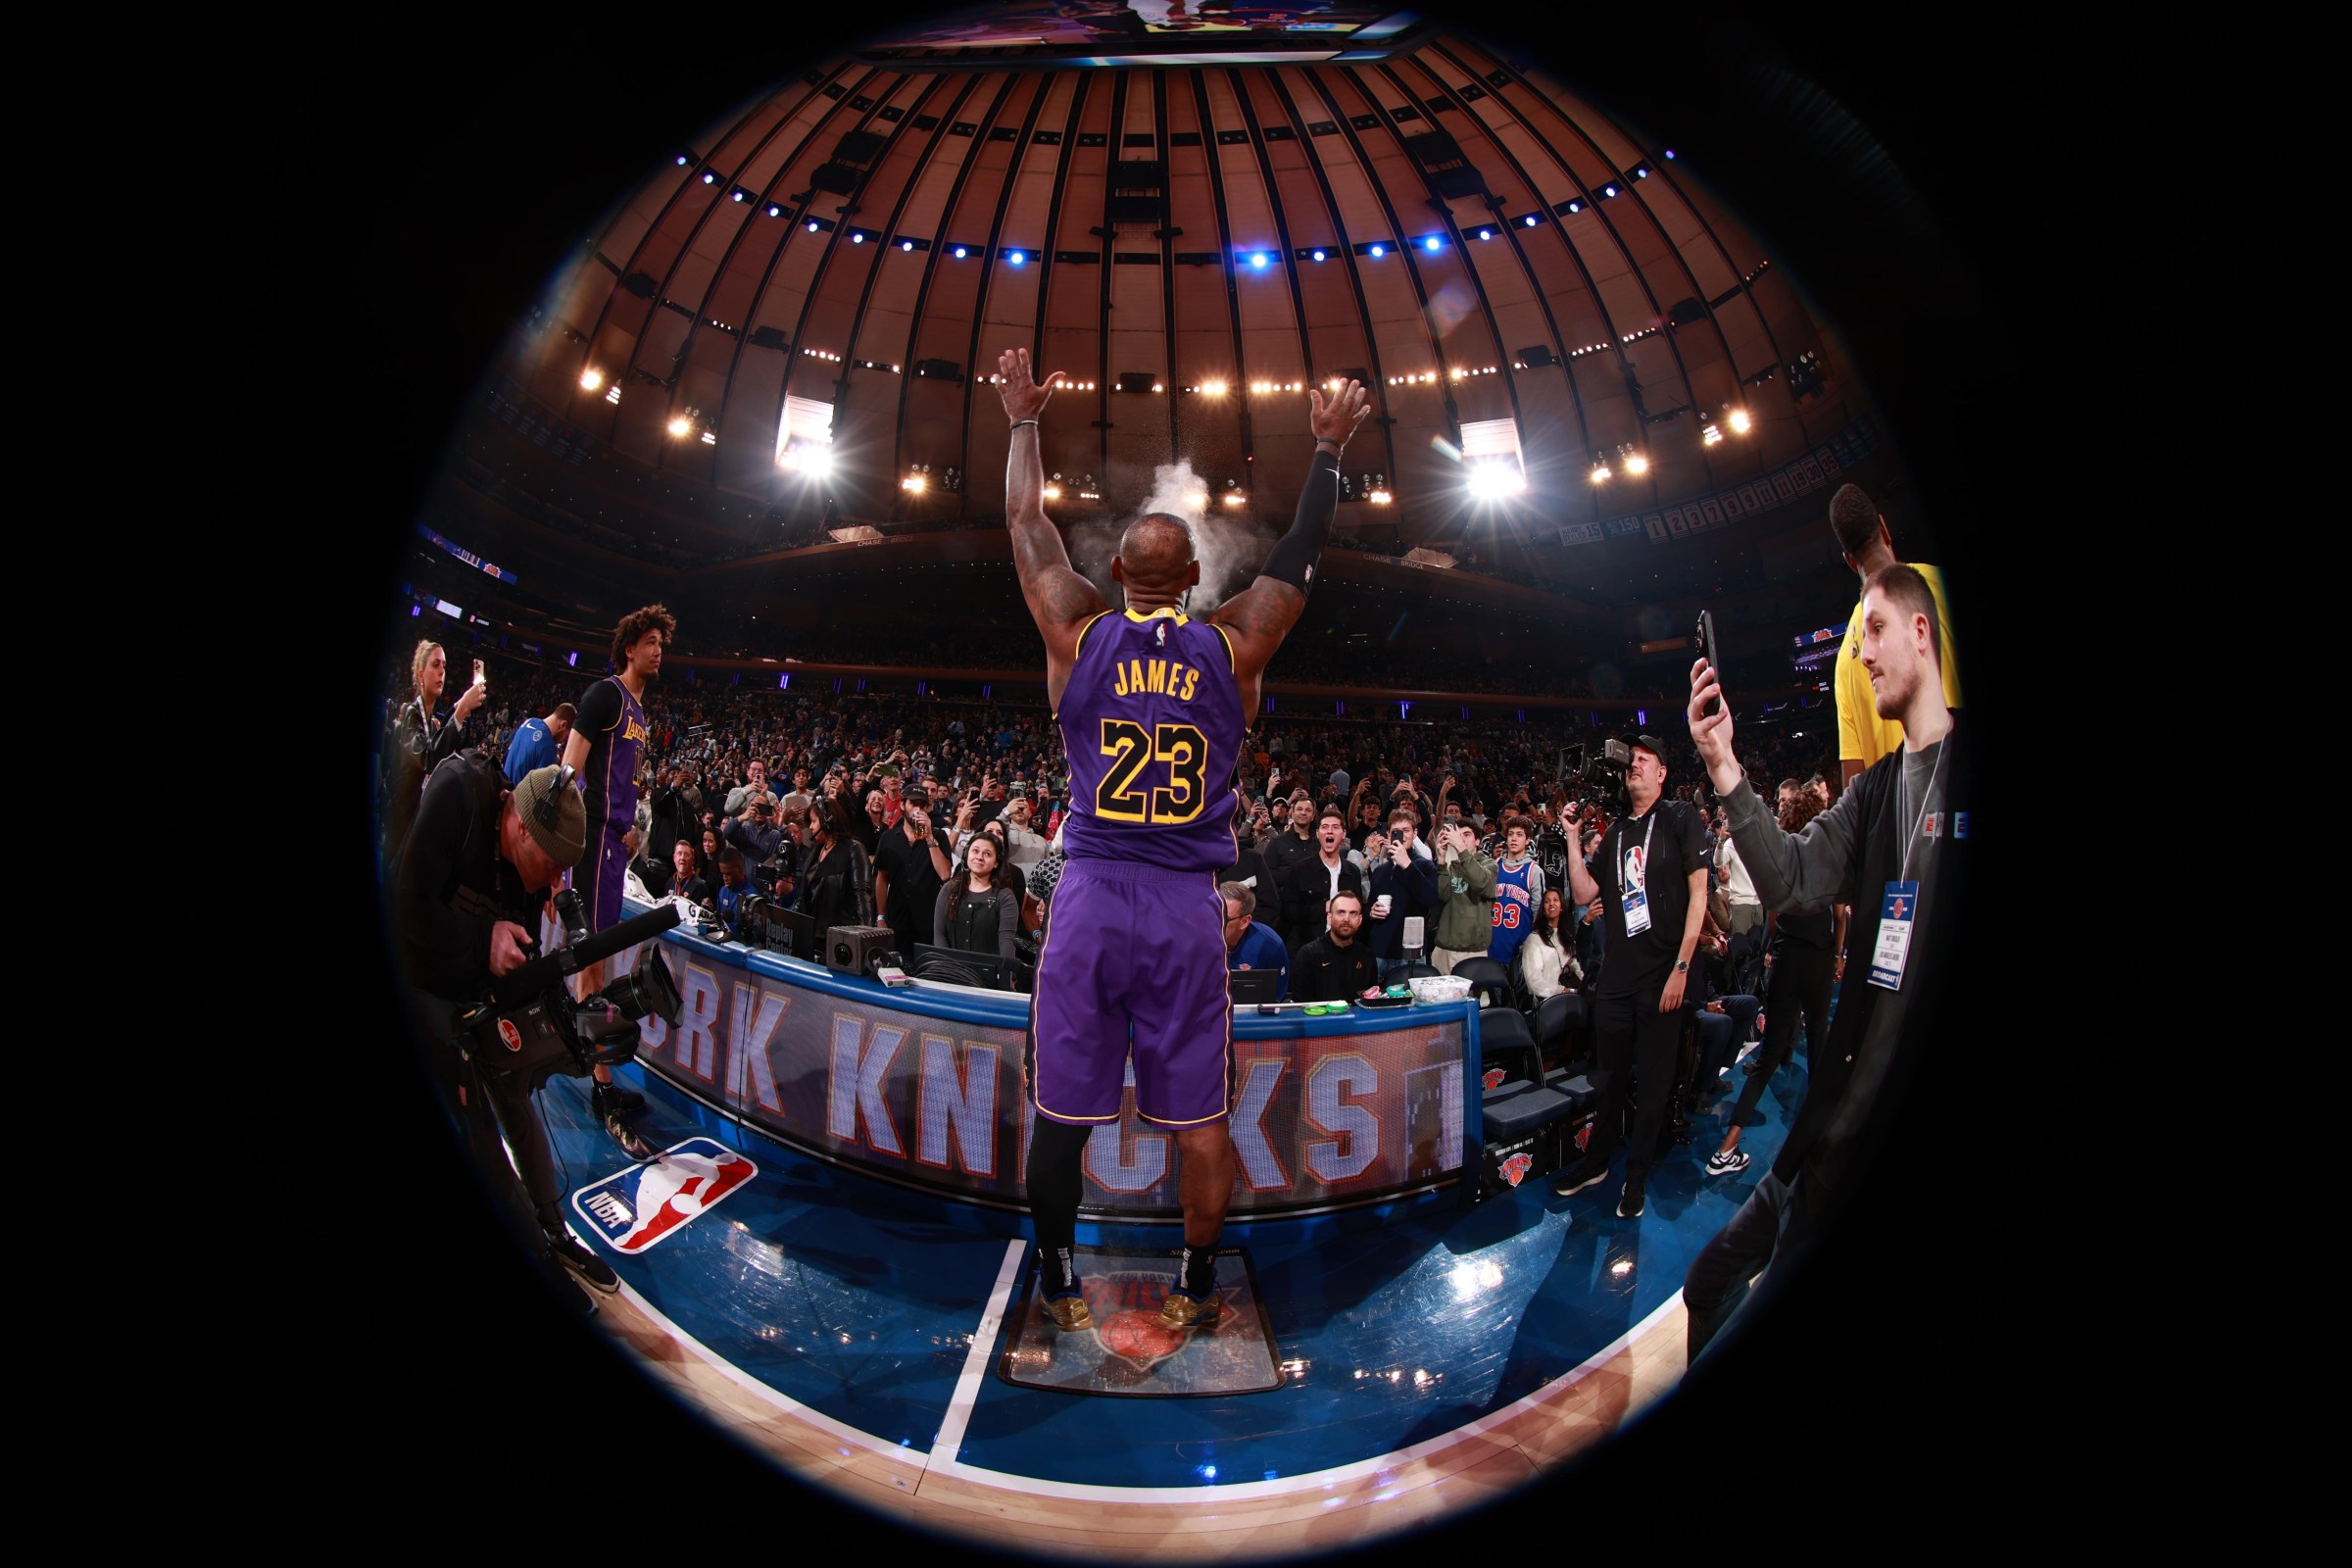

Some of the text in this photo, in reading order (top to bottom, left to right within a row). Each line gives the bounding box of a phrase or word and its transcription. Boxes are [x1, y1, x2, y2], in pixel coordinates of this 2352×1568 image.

[1791, 471, 1807, 489] 19
[1806, 464, 1822, 480] 30
[1759, 489, 1774, 503] 11
[1777, 479, 1791, 498] 11
[1726, 501, 1738, 514] 9
[1744, 493, 1755, 509] 9
[1671, 516, 1683, 531] 2
[1690, 512, 1701, 526] 3
[1586, 523, 1600, 538] 15
[1651, 522, 1661, 537] 1
[858, 538, 882, 547] CHASE
[1363, 553, 1424, 570] CHASE BRIDGE
[1114, 658, 1200, 702] JAMES
[1095, 717, 1208, 825] 23
[1505, 883, 1530, 907] YORK
[1491, 902, 1521, 929] 33
[765, 917, 794, 948] Replay
[1871, 969, 1897, 984] BROADCAST
